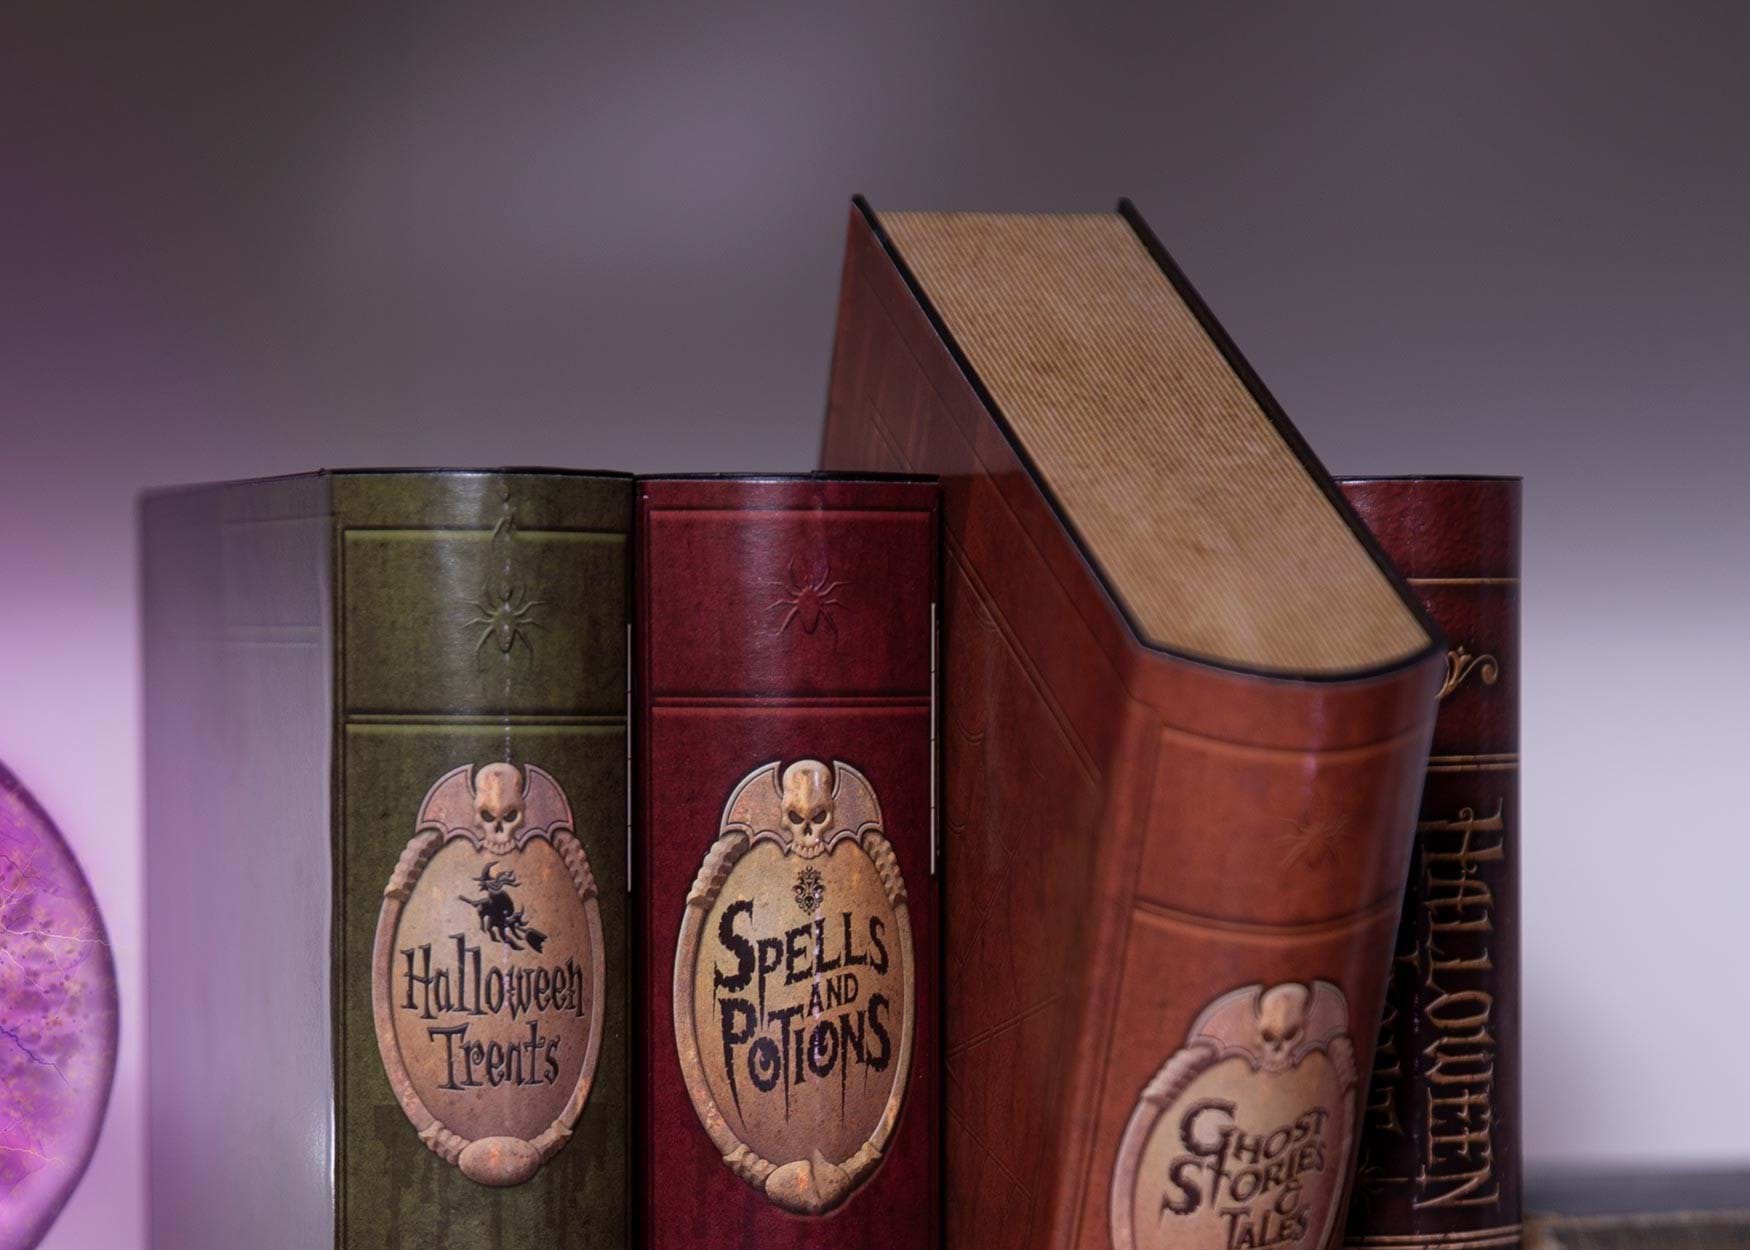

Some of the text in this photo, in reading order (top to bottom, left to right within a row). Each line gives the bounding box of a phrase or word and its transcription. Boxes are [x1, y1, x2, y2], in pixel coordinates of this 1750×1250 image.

[401, 932, 585, 1020] Halloween
[713, 898, 889, 1029] SPELLS
[807, 972, 859, 1017] AND
[1412, 798, 1504, 1212] HALLOWEEN
[718, 994, 891, 1132] POTIONS
[1179, 1099, 1328, 1166] GHOST
[1159, 1143, 1327, 1221] STORIES
